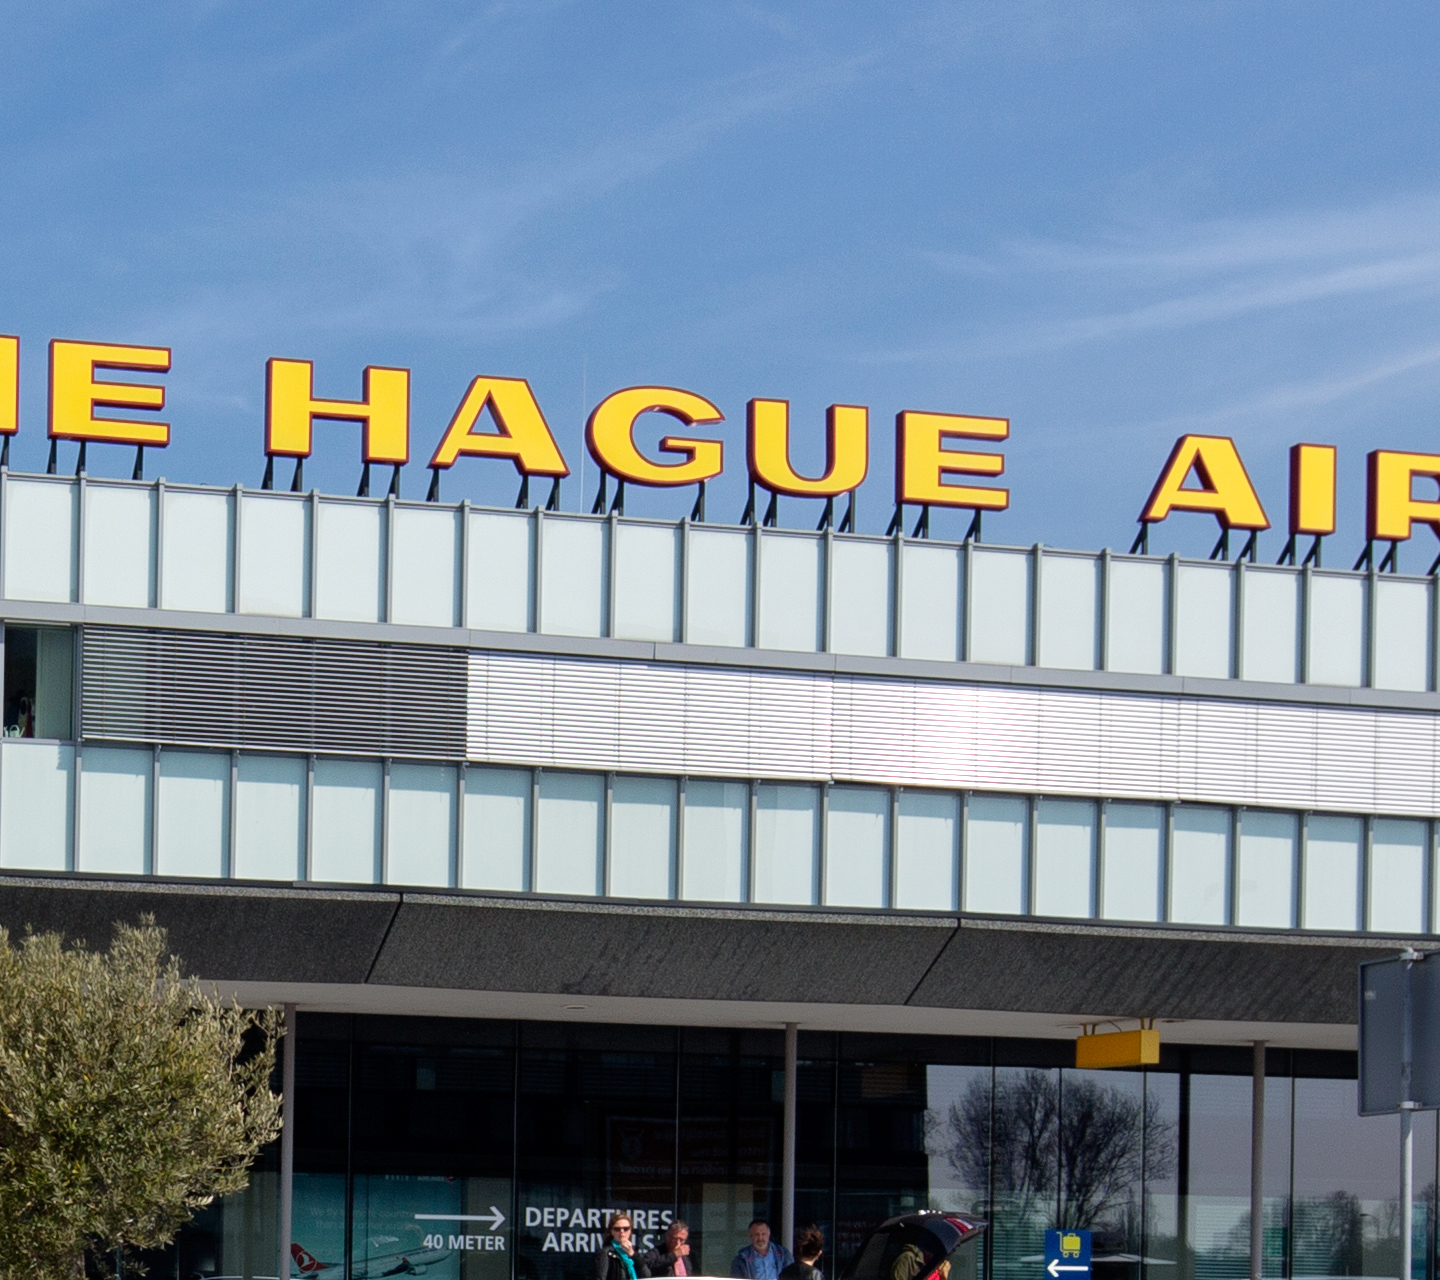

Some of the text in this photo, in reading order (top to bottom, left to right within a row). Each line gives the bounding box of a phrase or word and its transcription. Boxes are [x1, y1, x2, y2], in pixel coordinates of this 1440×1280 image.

[263, 356, 1010, 512] HAGUE
[423, 1234, 505, 1251] 40 METER
[542, 1231, 655, 1253] ARRILS
